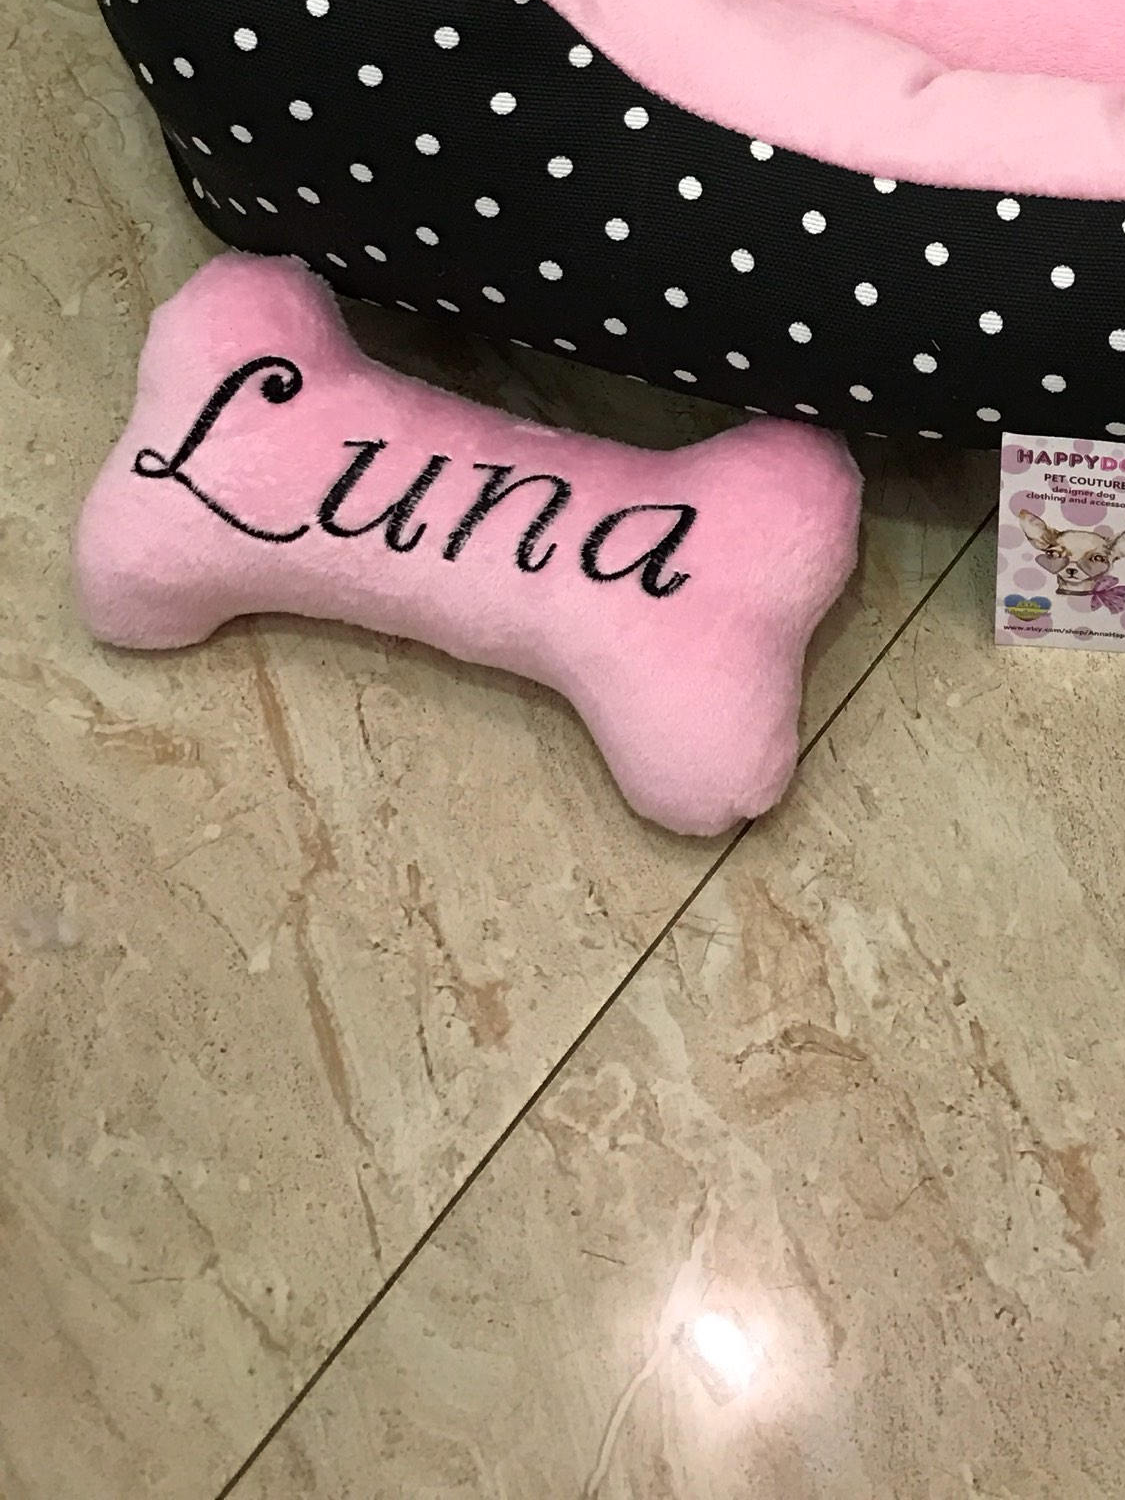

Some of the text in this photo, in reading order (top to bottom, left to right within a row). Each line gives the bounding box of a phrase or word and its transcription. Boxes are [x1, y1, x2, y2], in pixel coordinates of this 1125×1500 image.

[131, 355, 697, 598] Luna
[1044, 473, 1067, 483] PET
[1026, 492, 1066, 504] clothing
[1069, 496, 1087, 504] and
[1052, 486, 1116, 500] designer dog
